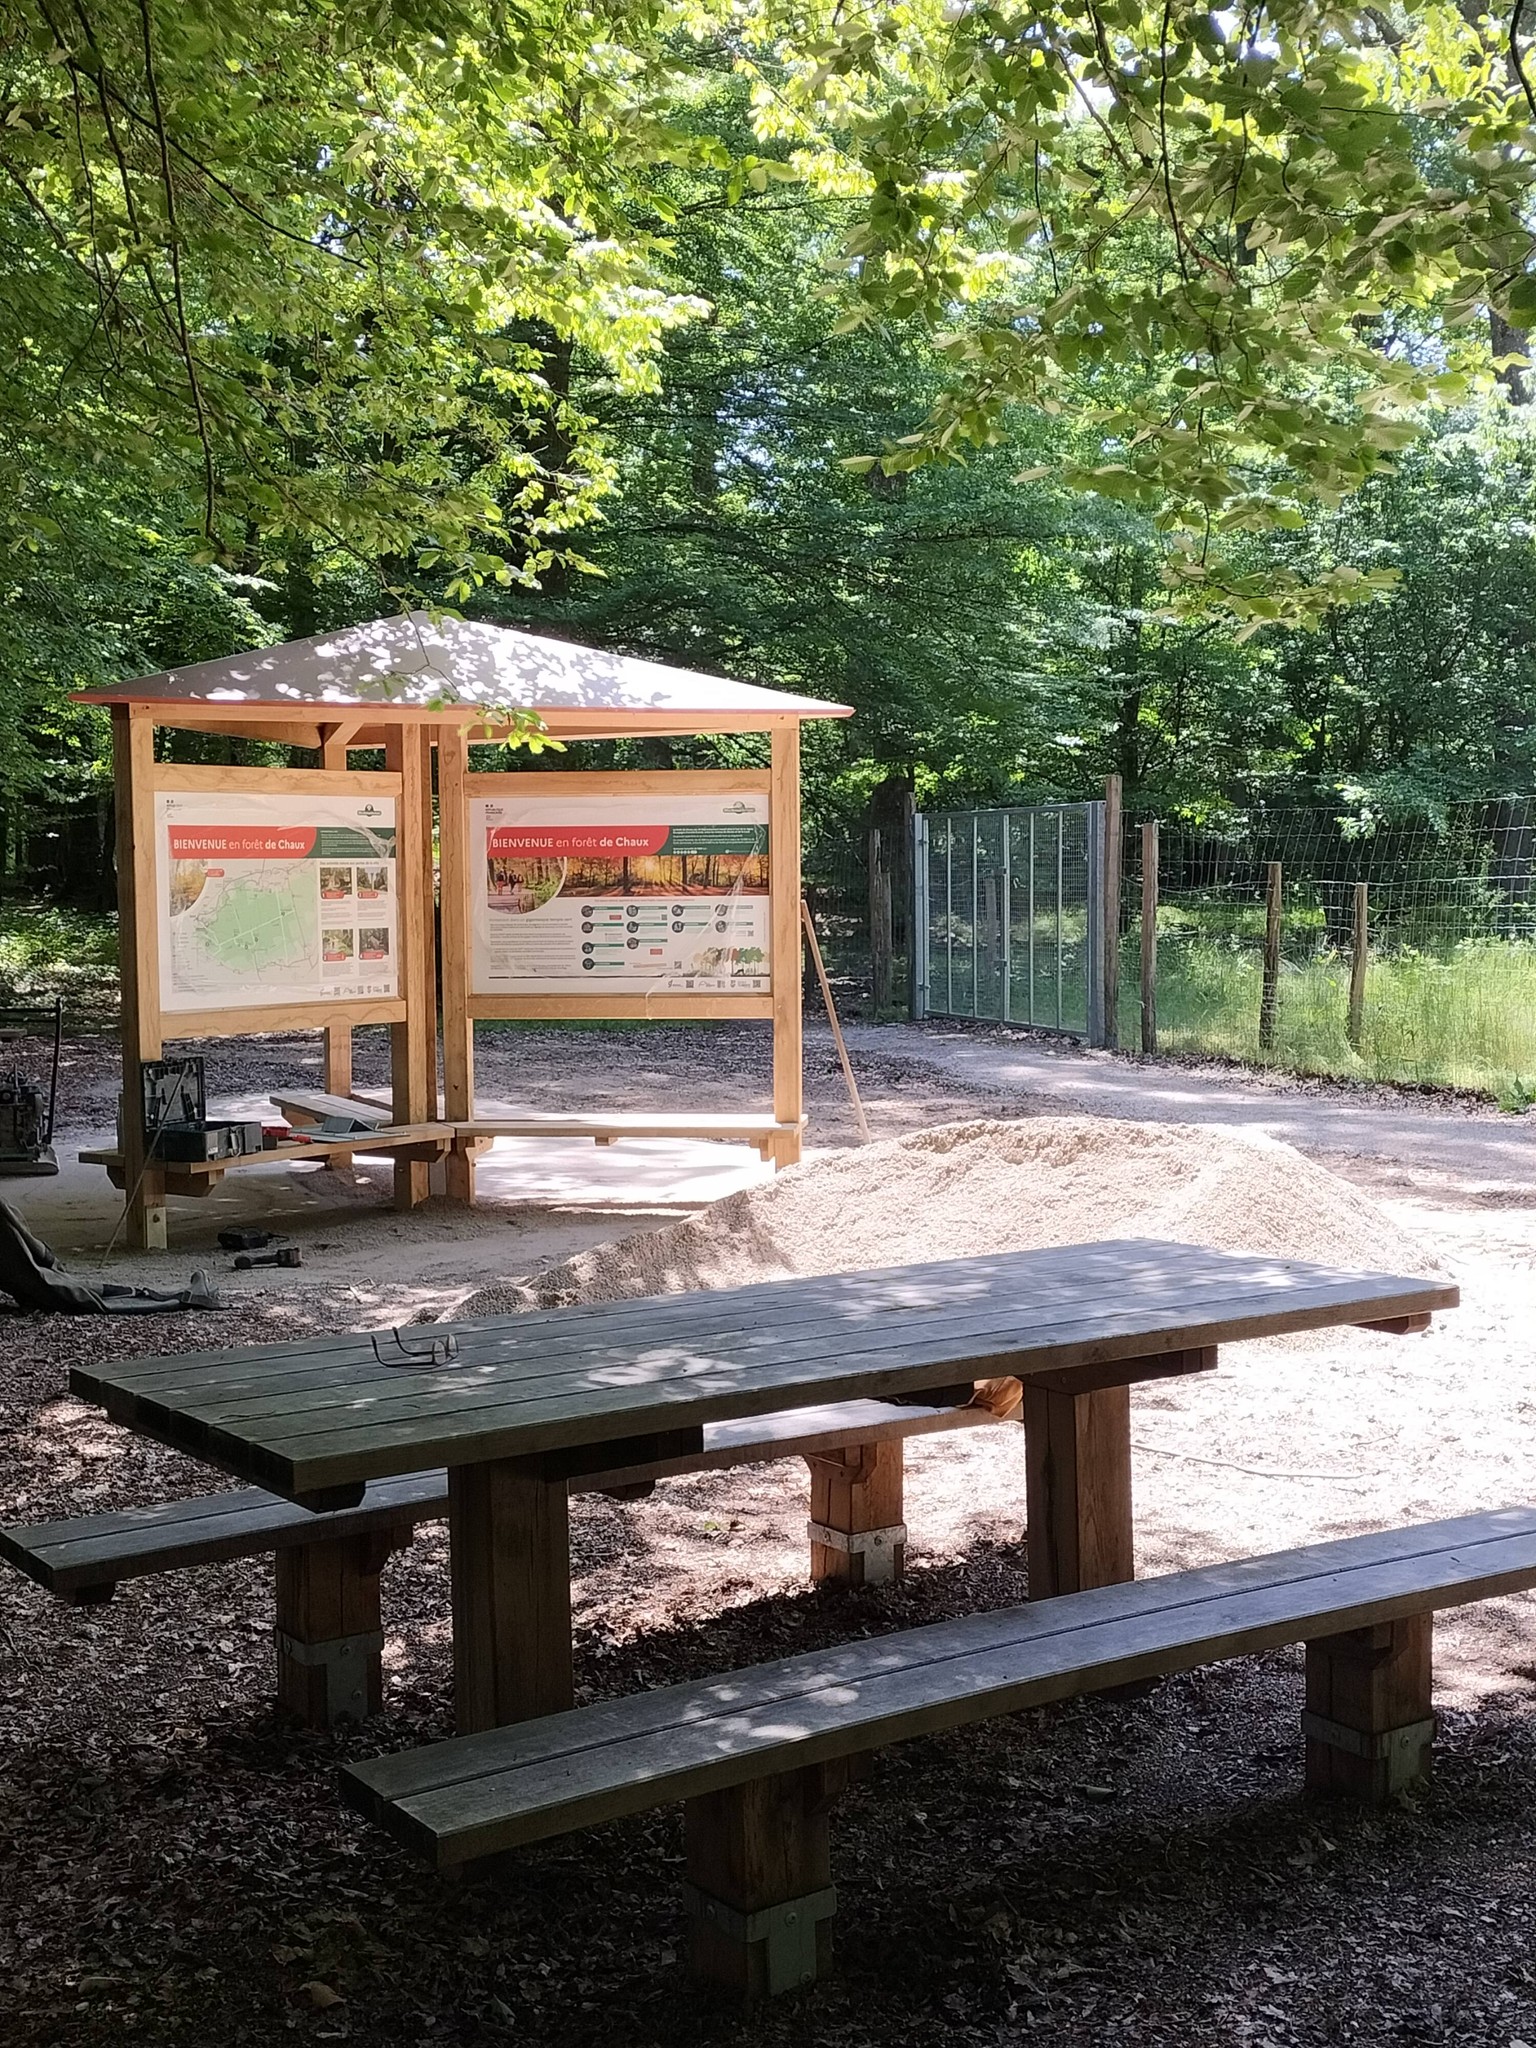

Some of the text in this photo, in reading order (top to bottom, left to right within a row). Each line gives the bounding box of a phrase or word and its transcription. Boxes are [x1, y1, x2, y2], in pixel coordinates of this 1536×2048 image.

[173, 838, 305, 850] BIENVENUE en forêt de Chaux
[492, 836, 649, 848] BIENVENUE en forêt de Chaux
